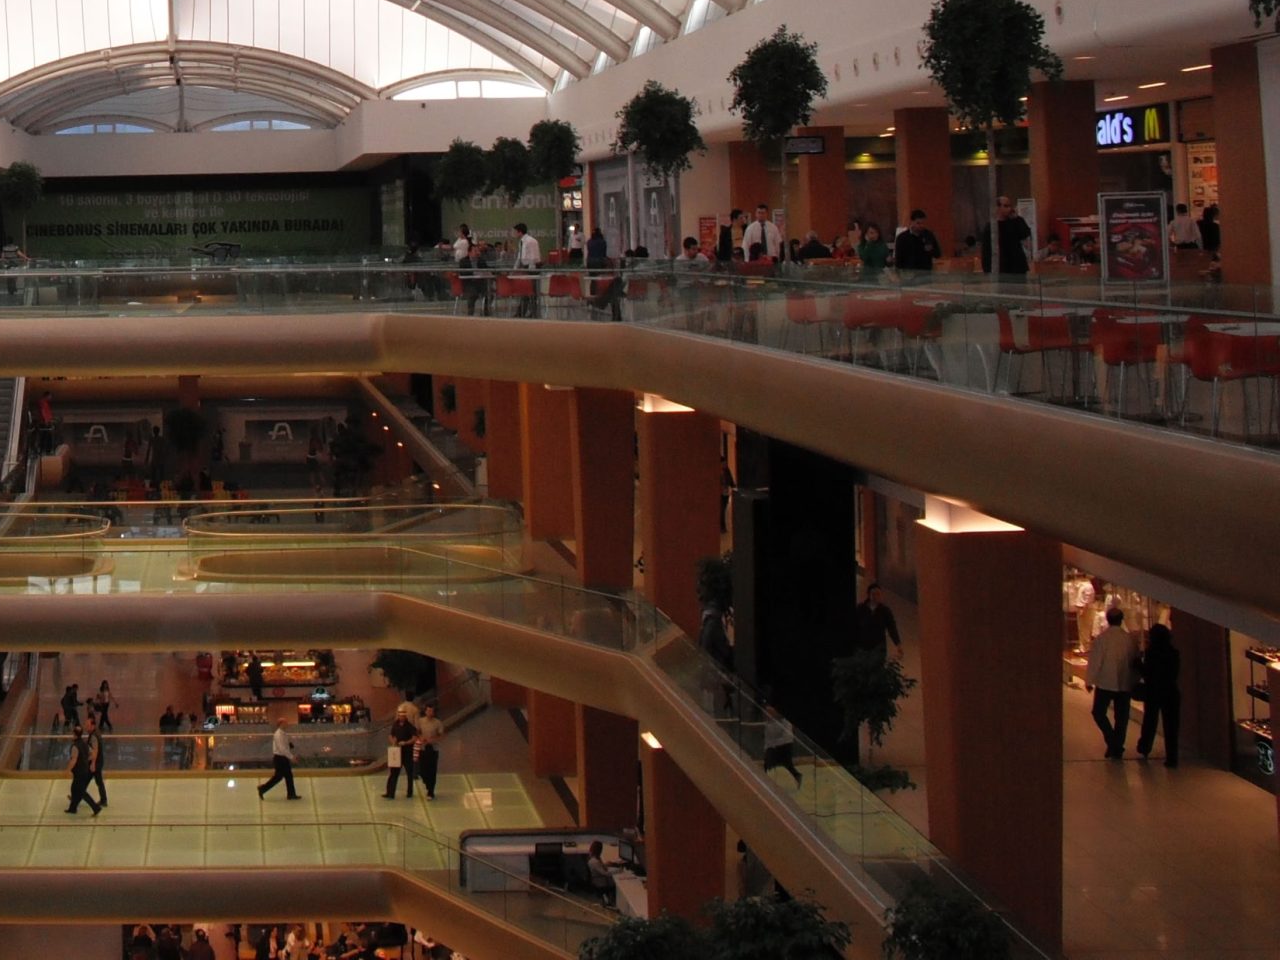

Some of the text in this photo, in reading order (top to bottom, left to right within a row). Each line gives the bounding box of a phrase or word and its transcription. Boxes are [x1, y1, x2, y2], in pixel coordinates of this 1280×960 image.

[192, 222, 217, 238] ÇOK
[221, 218, 280, 235] YAKINDA
[284, 218, 344, 233] BURADA!
